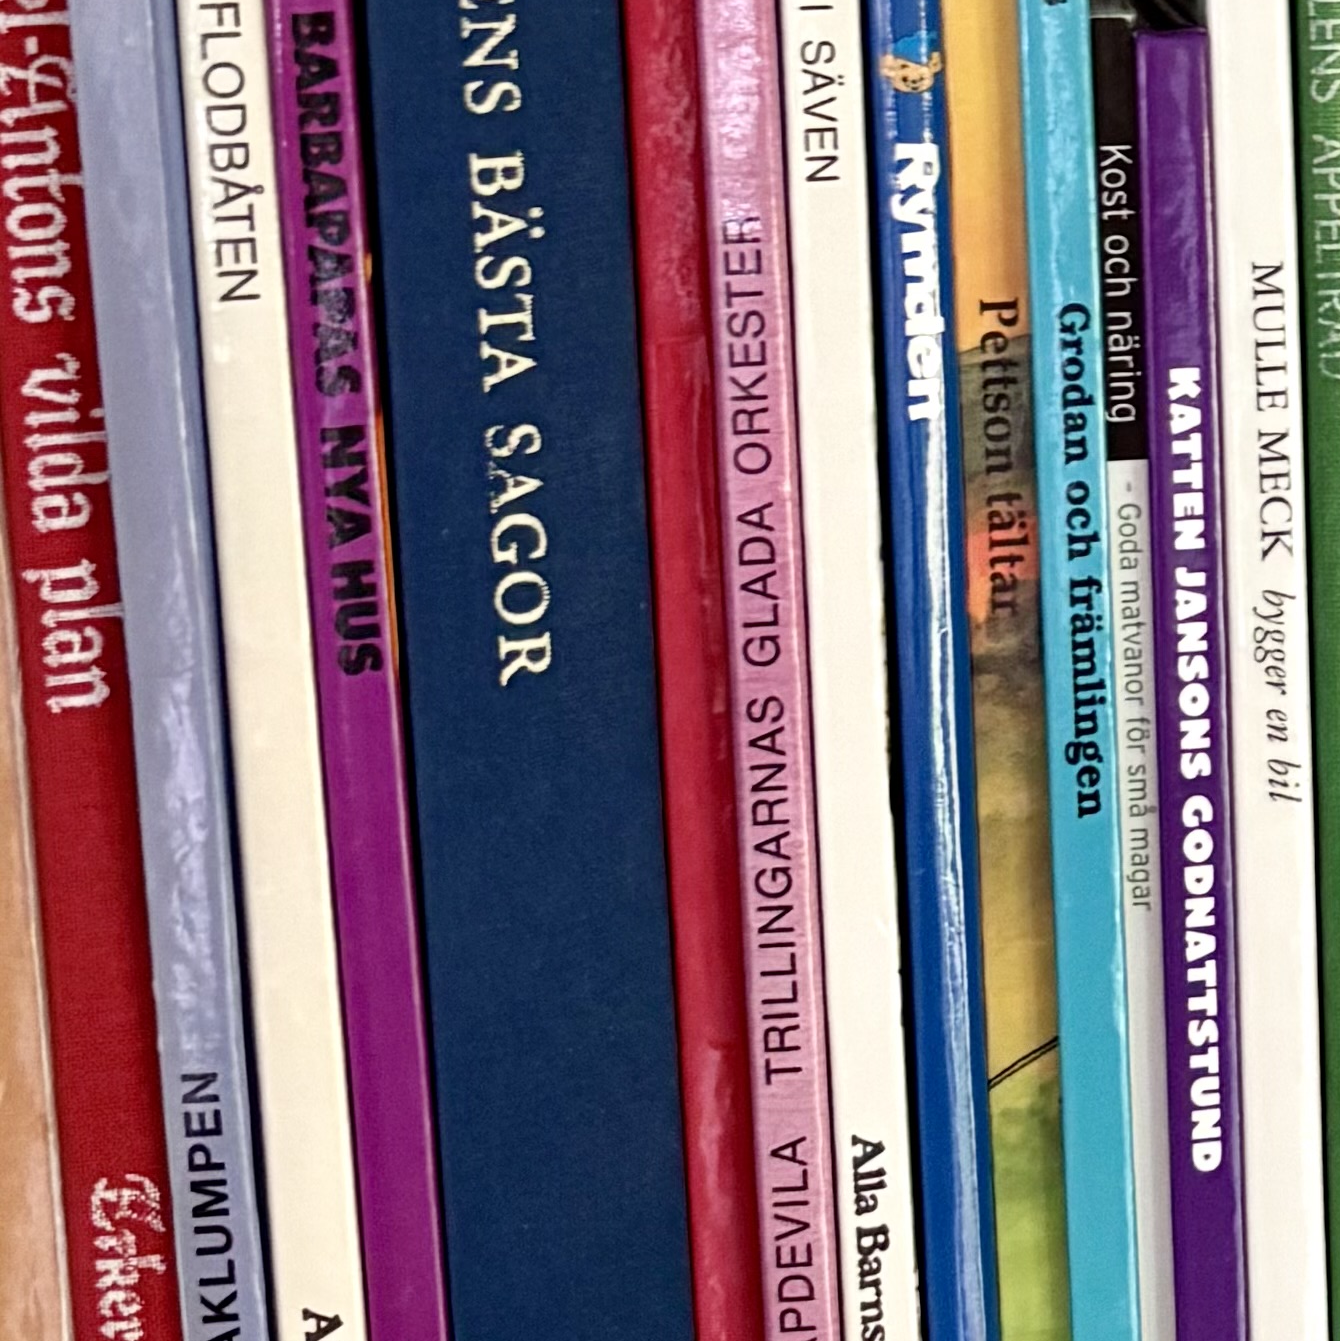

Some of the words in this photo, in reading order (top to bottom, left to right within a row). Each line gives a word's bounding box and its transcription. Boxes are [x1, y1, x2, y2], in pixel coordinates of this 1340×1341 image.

[198, 2, 265, 302] FLODBÅTEN
[800, 40, 846, 184] SÄVEN
[1099, 145, 1136, 220] Kost
[291, 11, 364, 397] BARBAPAPAS
[469, 151, 546, 393] BÄSTA
[1103, 233, 1138, 298] och
[723, 214, 771, 476] ORKESTER
[887, 142, 946, 422] Rymden
[1251, 262, 1289, 413] MULLE
[22, 353, 109, 533] vilda
[978, 298, 1019, 476] Pettson
[1055, 302, 1094, 465] Grodan
[1104, 311, 1143, 424] näring
[319, 425, 372, 548] NYA
[1064, 479, 1101, 562] och
[1168, 366, 1206, 551] KATTEN
[1257, 431, 1294, 561] MECK
[483, 424, 552, 686] SAGOR
[737, 501, 781, 669] GLADA
[986, 489, 1031, 617] tältar
[1117, 502, 1147, 572] Goda
[24, 559, 125, 713] plan
[330, 560, 383, 676] HUS
[1119, 582, 1148, 706] matvanor
[1173, 567, 1213, 781] JANSONS
[1251, 589, 1295, 696] bygger
[1065, 573, 1107, 820] främlingen
[1124, 716, 1152, 754] för
[1127, 765, 1157, 817] små
[742, 693, 802, 1085] TRILLINGARNAS
[1128, 828, 1155, 912] magar
[1181, 795, 1222, 1173] GODNATTSTUND
[850, 1134, 889, 1216] Alla
